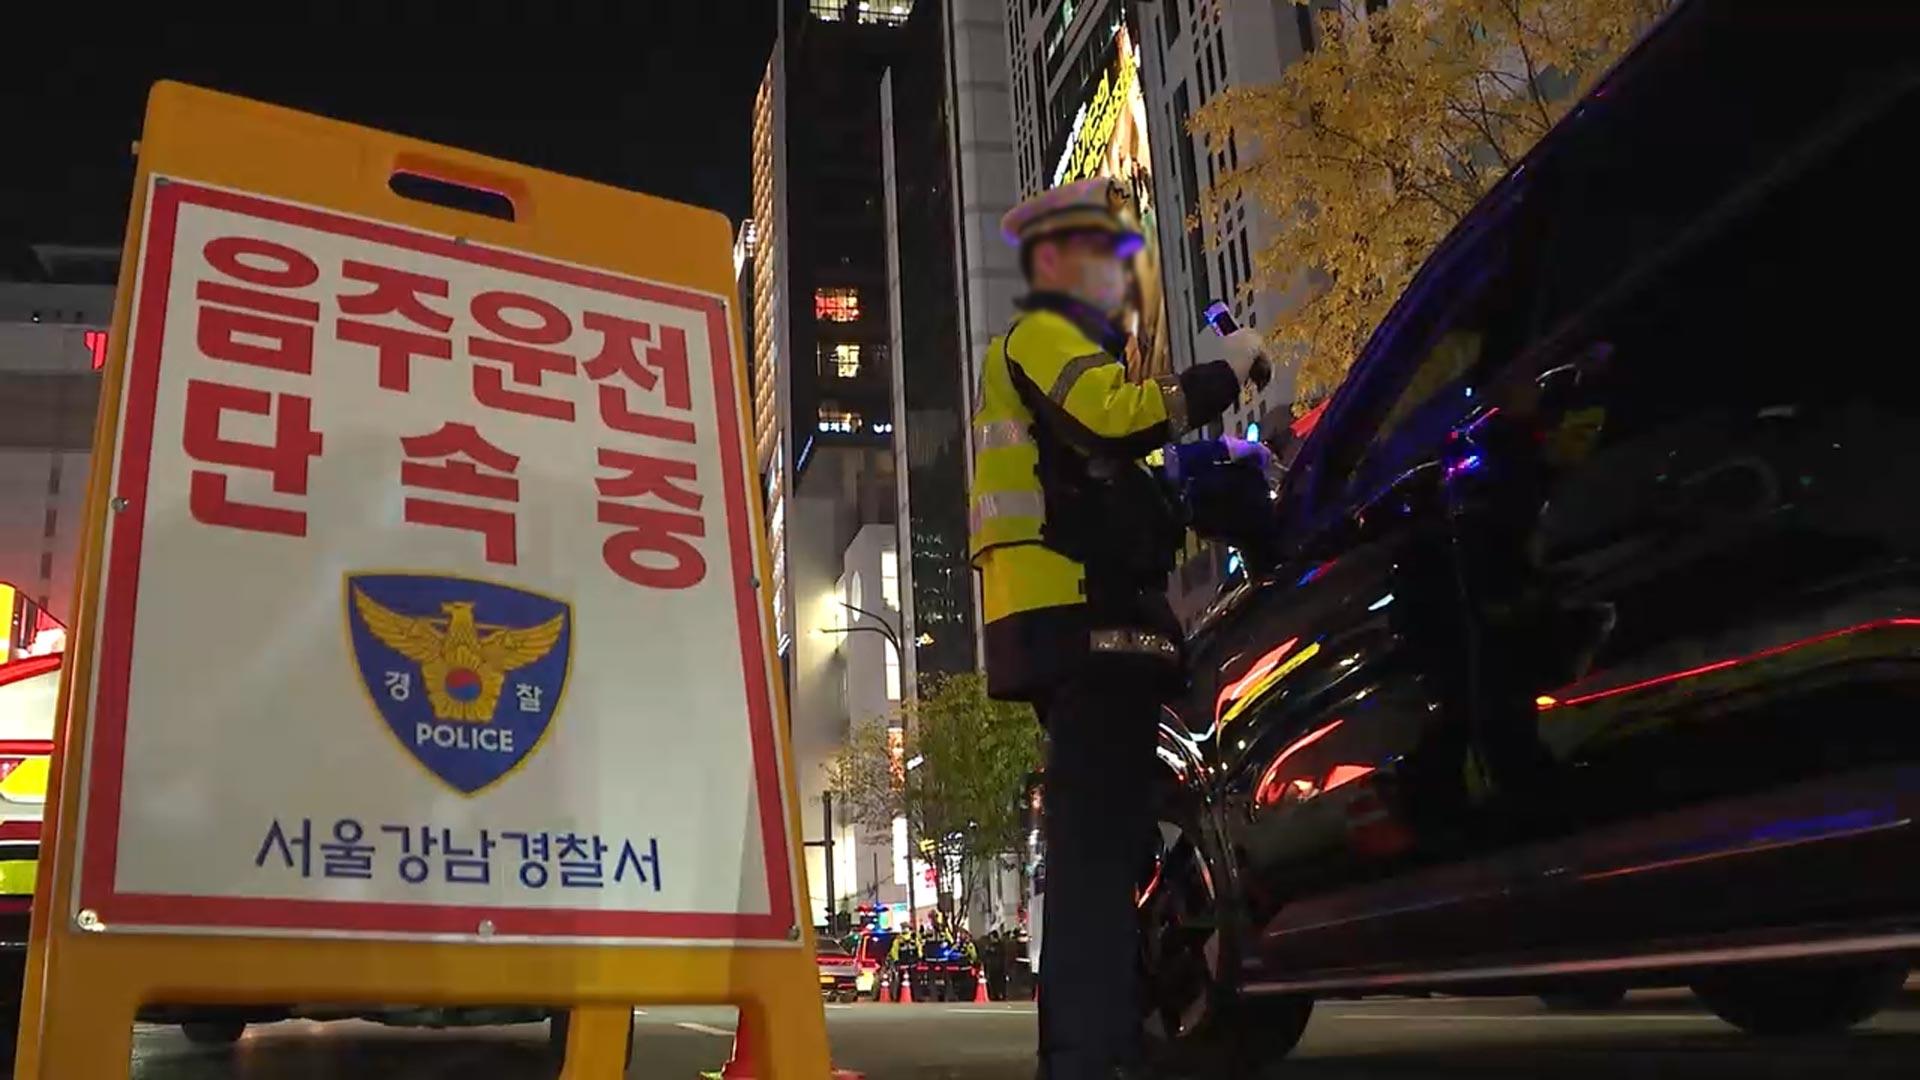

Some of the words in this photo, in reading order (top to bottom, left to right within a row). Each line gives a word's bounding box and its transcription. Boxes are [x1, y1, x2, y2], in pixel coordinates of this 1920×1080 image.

[196, 236, 697, 443] 음주운전
[385, 671, 411, 702] 경
[516, 683, 543, 713] 찰
[415, 722, 515, 753] POLICE
[255, 817, 662, 892] 서울강남경찰서
